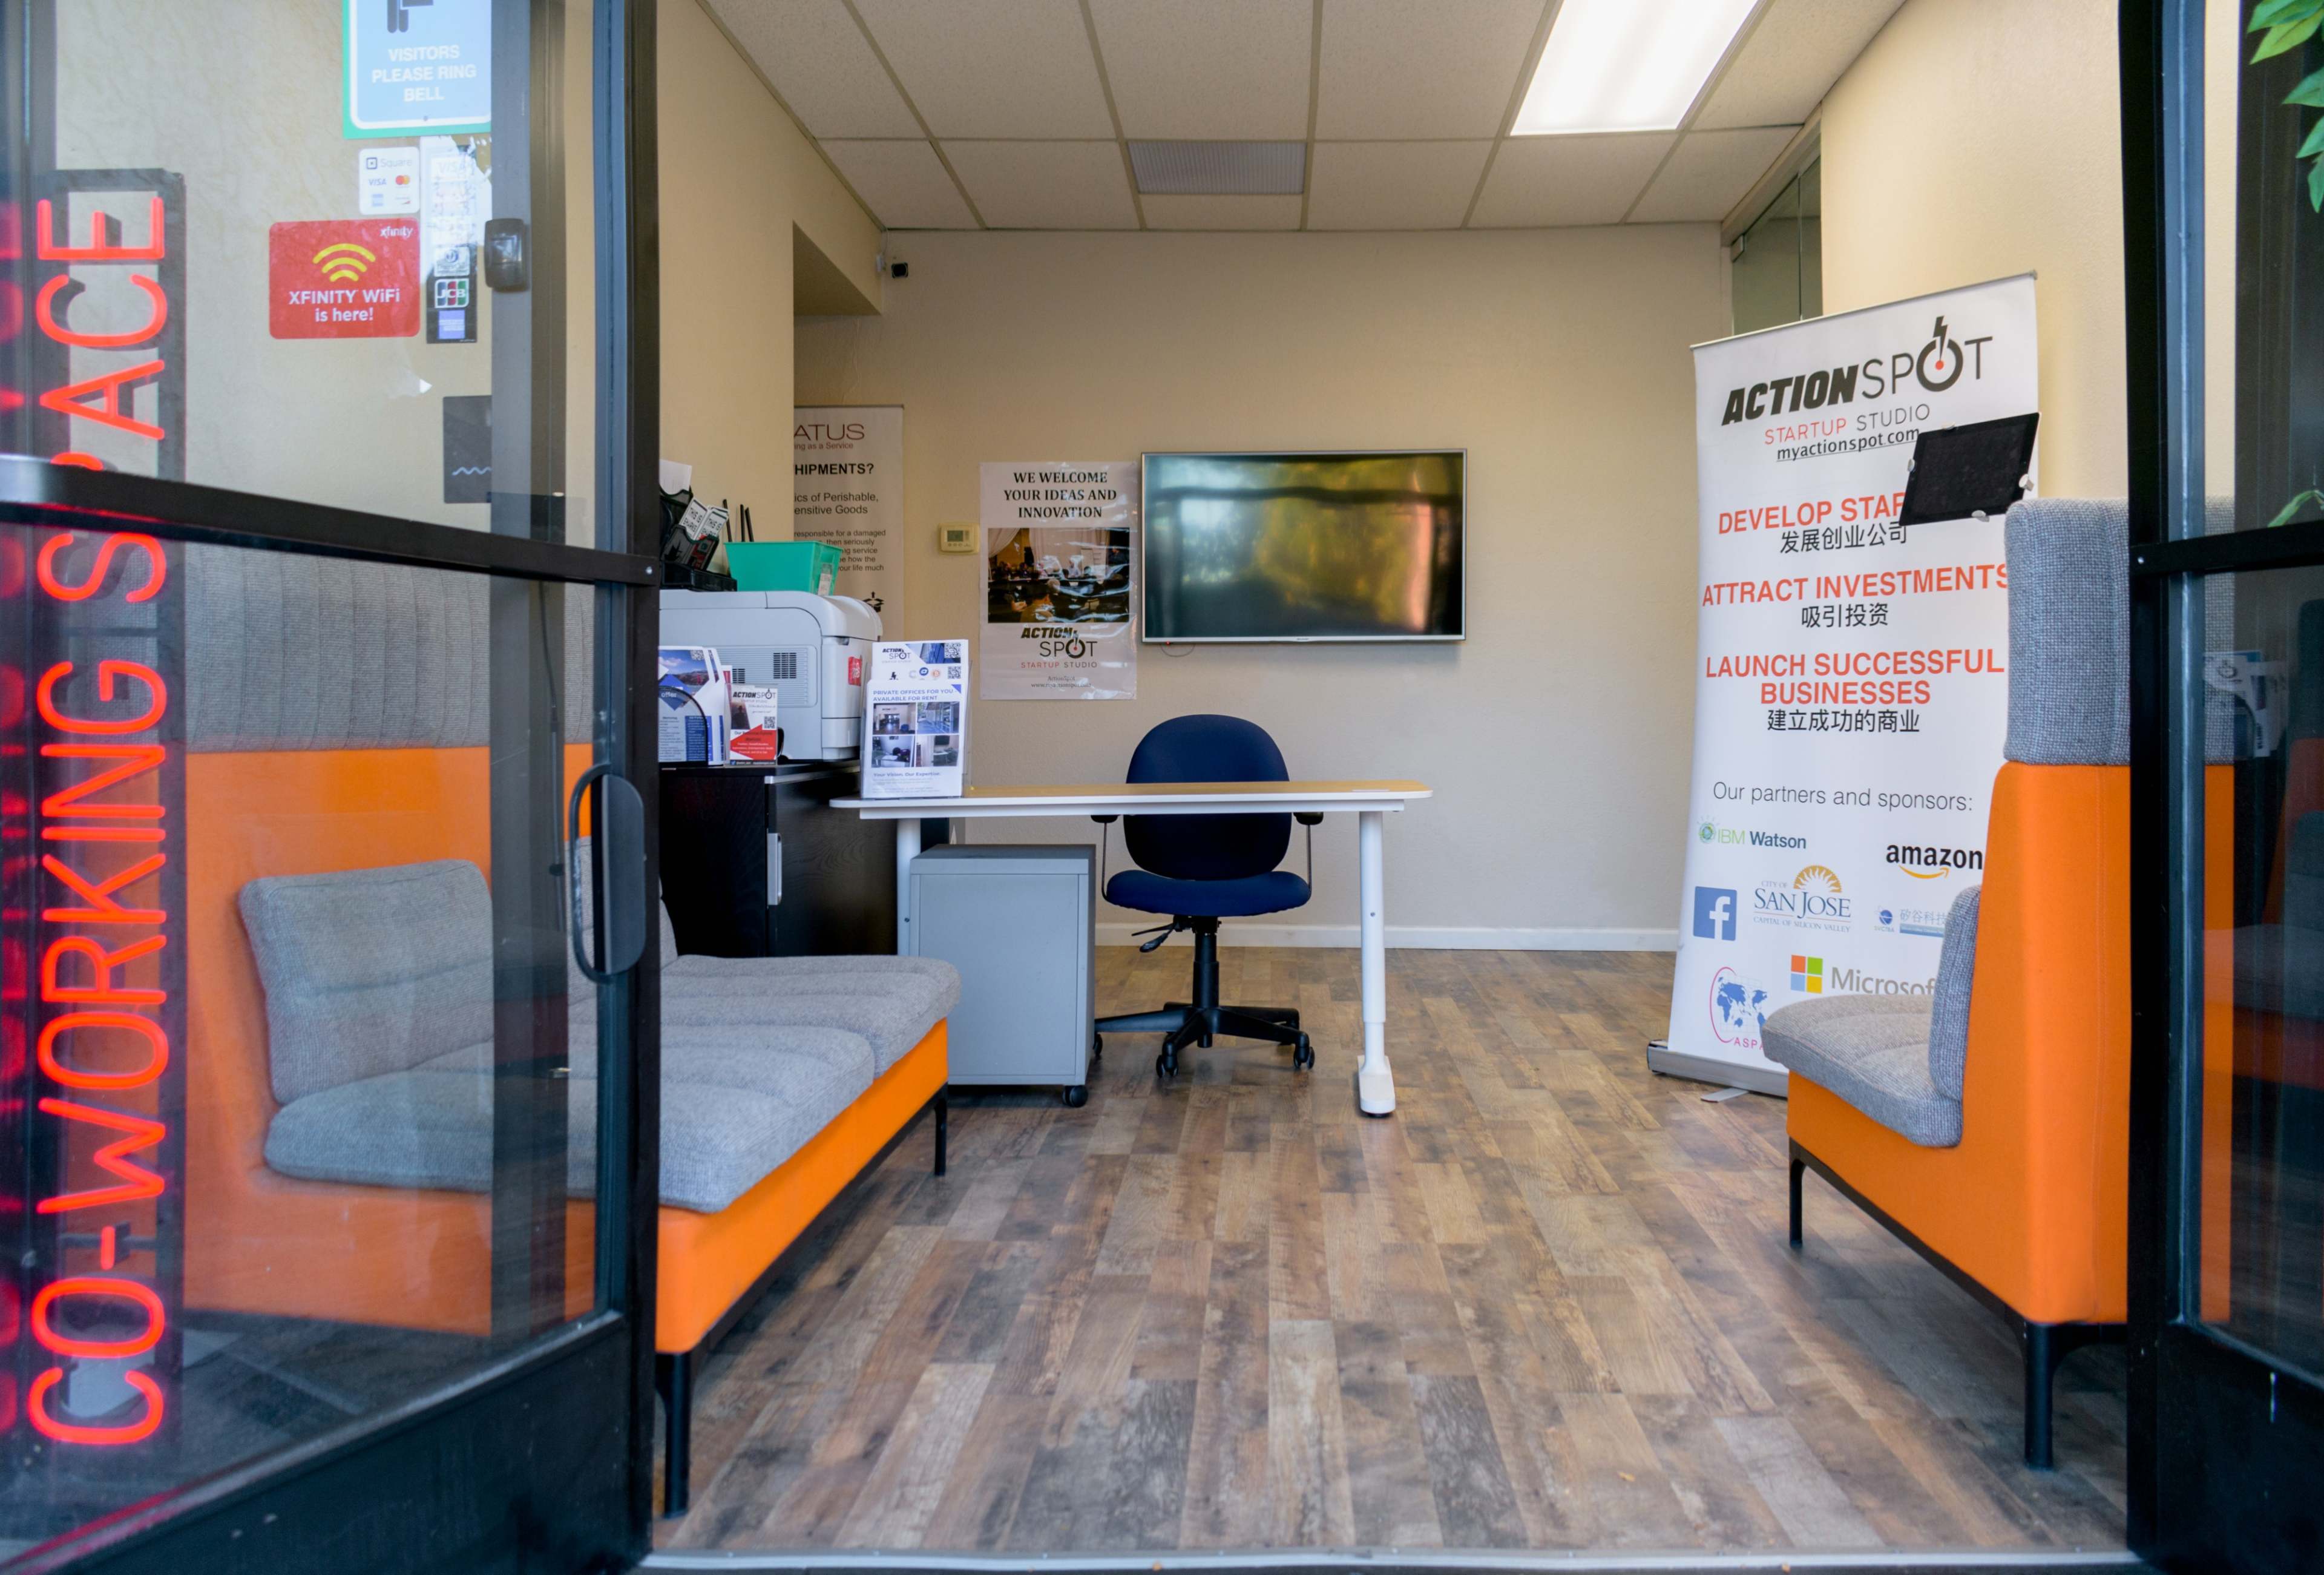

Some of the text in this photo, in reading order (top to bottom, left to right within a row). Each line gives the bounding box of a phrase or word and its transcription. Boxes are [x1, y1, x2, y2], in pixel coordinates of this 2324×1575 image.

[388, 45, 460, 62] VISITORS
[372, 64, 477, 83] PLEASE RING
[403, 87, 445, 102] BELL
[380, 158, 413, 168] Square
[379, 226, 413, 238] xfinity
[288, 288, 401, 306] XFINITY WiFi
[436, 289, 466, 299] JCB
[315, 307, 374, 322] is here!
[794, 424, 865, 441] ATUS
[1764, 404, 1931, 446] STARTUP STUDIO
[794, 442, 806, 452] ing
[1777, 427, 1920, 462] myactionspot.com
[795, 463, 875, 475] HIPMENTS?
[1013, 472, 1108, 484] WE WELCOME
[794, 492, 879, 502] ics of Perishable,
[1003, 489, 1117, 501] YOUR IDEAS AND
[794, 504, 868, 515] ensitive Goods
[1019, 507, 1103, 519] INNOVATION
[1718, 500, 1833, 535] DEVELOP
[853, 529, 886, 538] damaged
[1779, 521, 1907, 554] 发展创业公司
[844, 538, 875, 547] seriously
[1702, 563, 2008, 607] ATTRACT INVESTMENTS
[1800, 602, 1889, 628] 吸引投资
[1020, 627, 1074, 639] ACTION
[1039, 637, 1098, 659] SPOT
[1705, 648, 2004, 678] LAUNCH SUCCESSFUL
[1761, 679, 1931, 705] BUSINESSES
[1767, 708, 1920, 733] 建立成功的商业
[1713, 781, 1974, 812] Our partners and sponsors:
[27, 196, 169, 1445] CO-WORKING SACE
[1718, 829, 1807, 849] IBM Watson
[1885, 844, 1983, 870] amazon
[1761, 880, 1777, 889] CITY
[1754, 887, 1851, 919] SAN JOSE
[1753, 916, 1780, 926] CAPITAL
[1794, 921, 1822, 930] SILICON
[1823, 923, 1851, 933] VALLEY
[1831, 967, 1935, 995] Microsof
